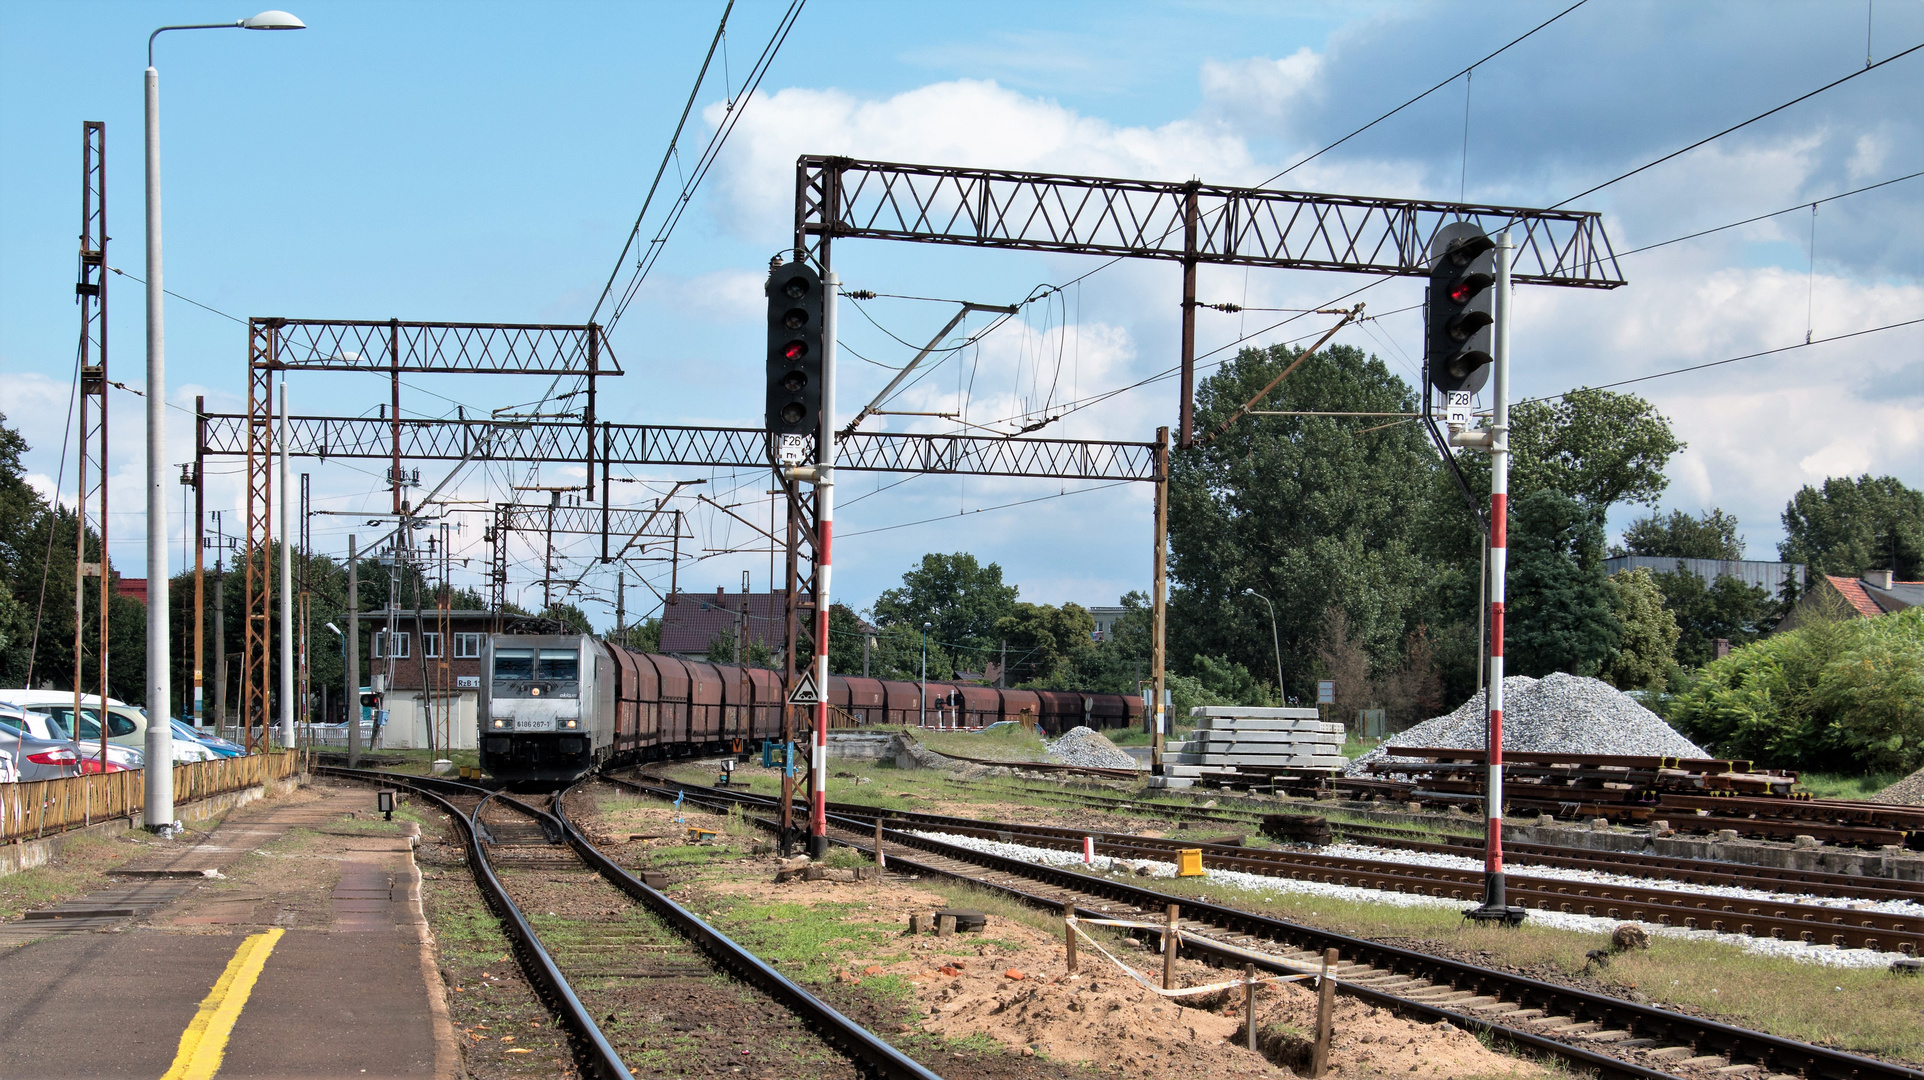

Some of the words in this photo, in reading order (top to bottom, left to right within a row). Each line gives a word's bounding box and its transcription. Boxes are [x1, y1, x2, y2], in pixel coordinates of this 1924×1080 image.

[1448, 392, 1469, 405] F28
[1452, 413, 1464, 421] m
[783, 435, 801, 446] F26
